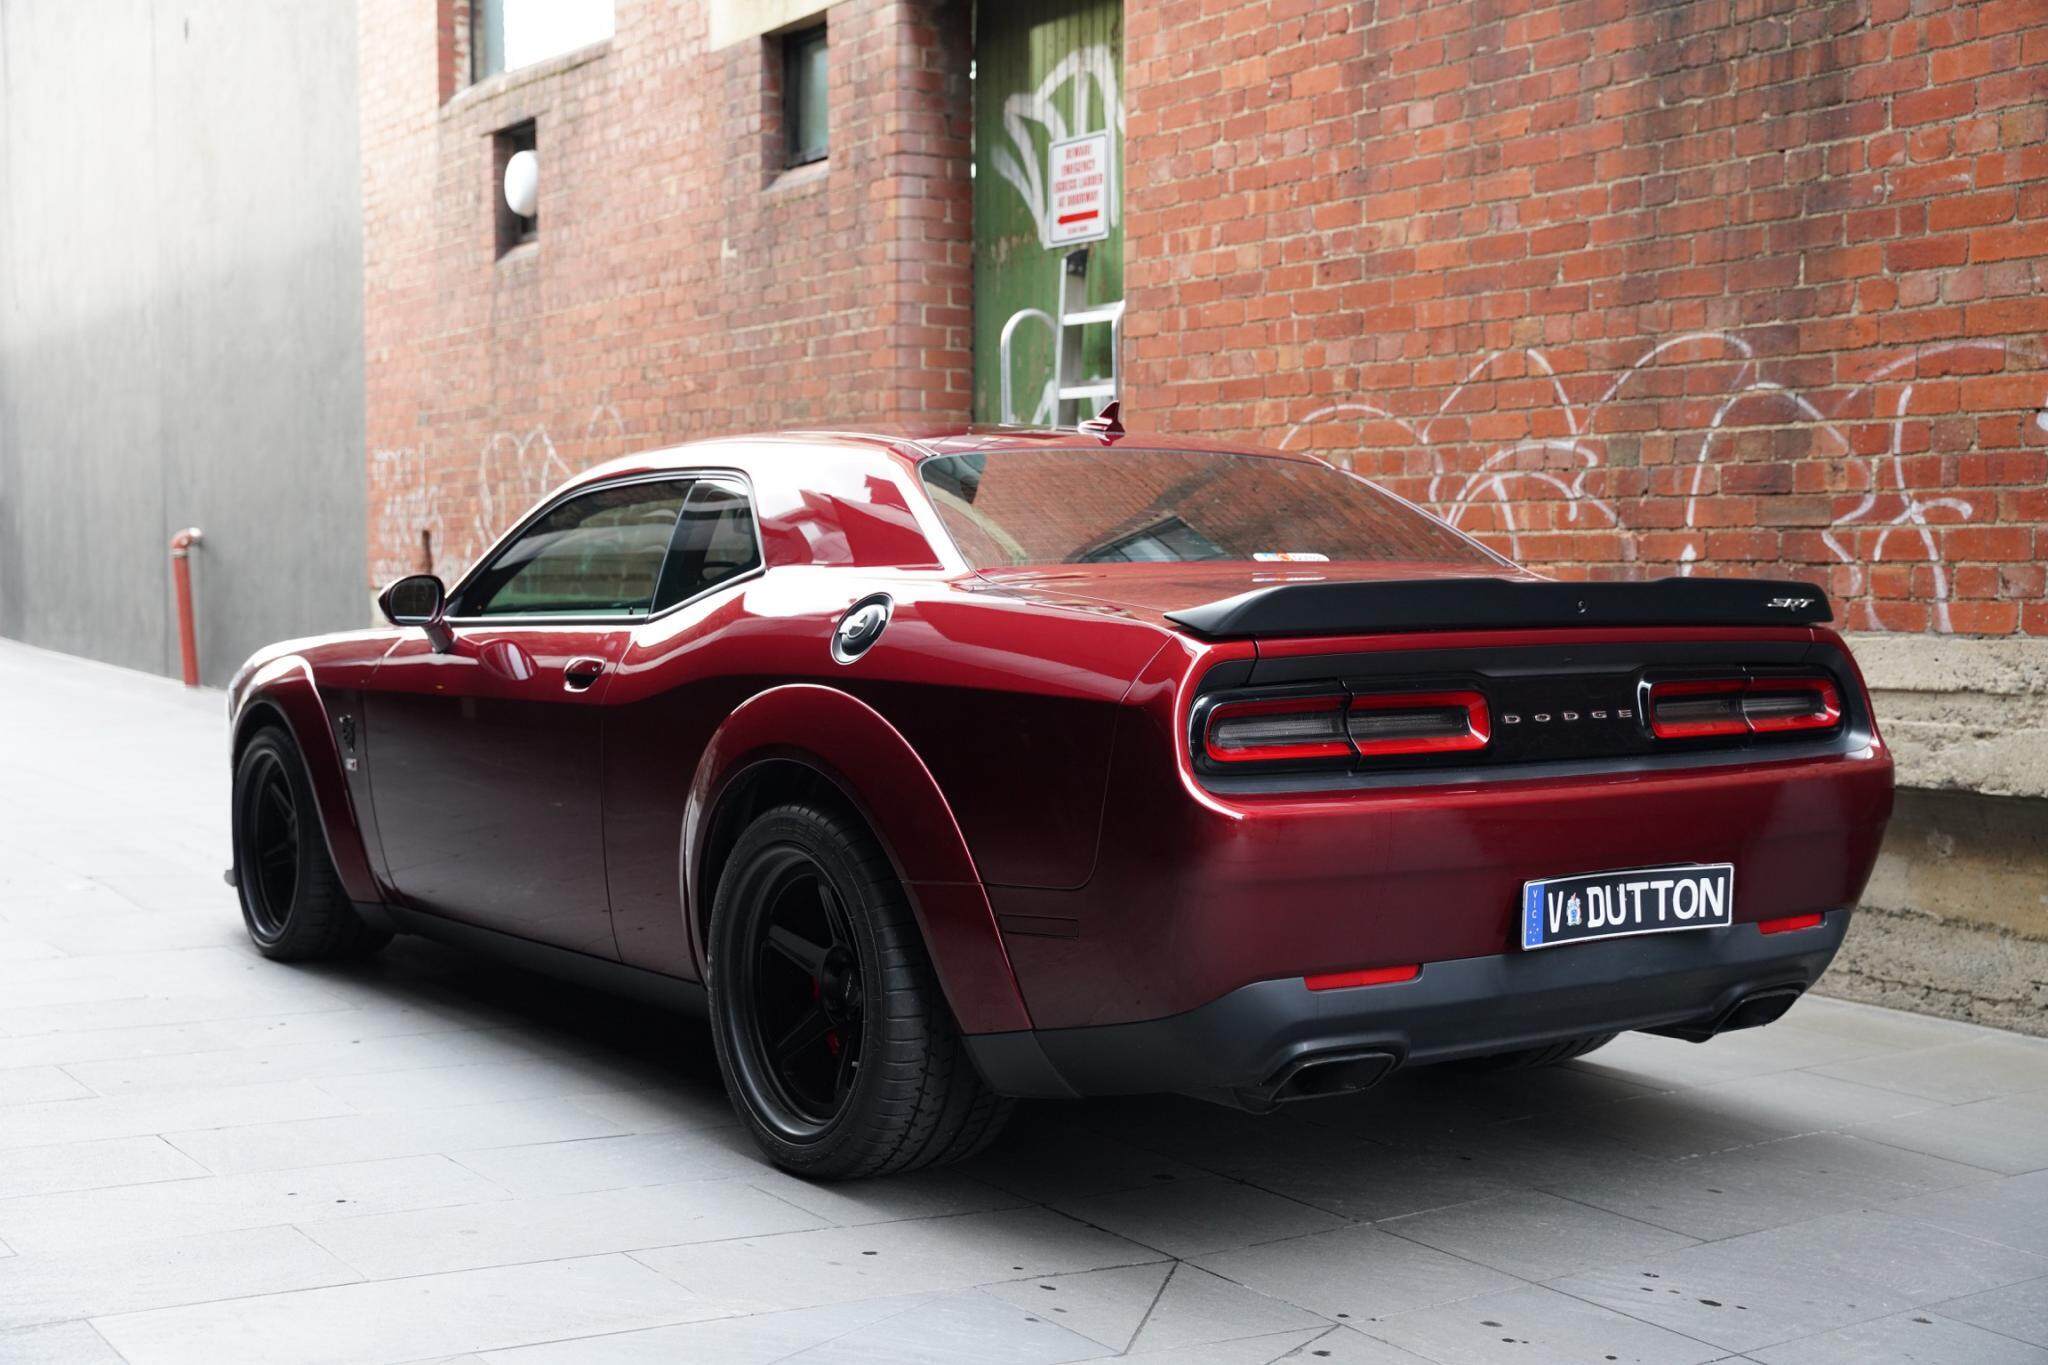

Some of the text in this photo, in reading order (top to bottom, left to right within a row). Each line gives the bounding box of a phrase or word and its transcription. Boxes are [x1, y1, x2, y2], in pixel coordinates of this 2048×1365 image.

[1767, 598, 1815, 611] SRT
[1504, 709, 1633, 724] DODGE
[1548, 876, 1725, 933] V DUTTON
